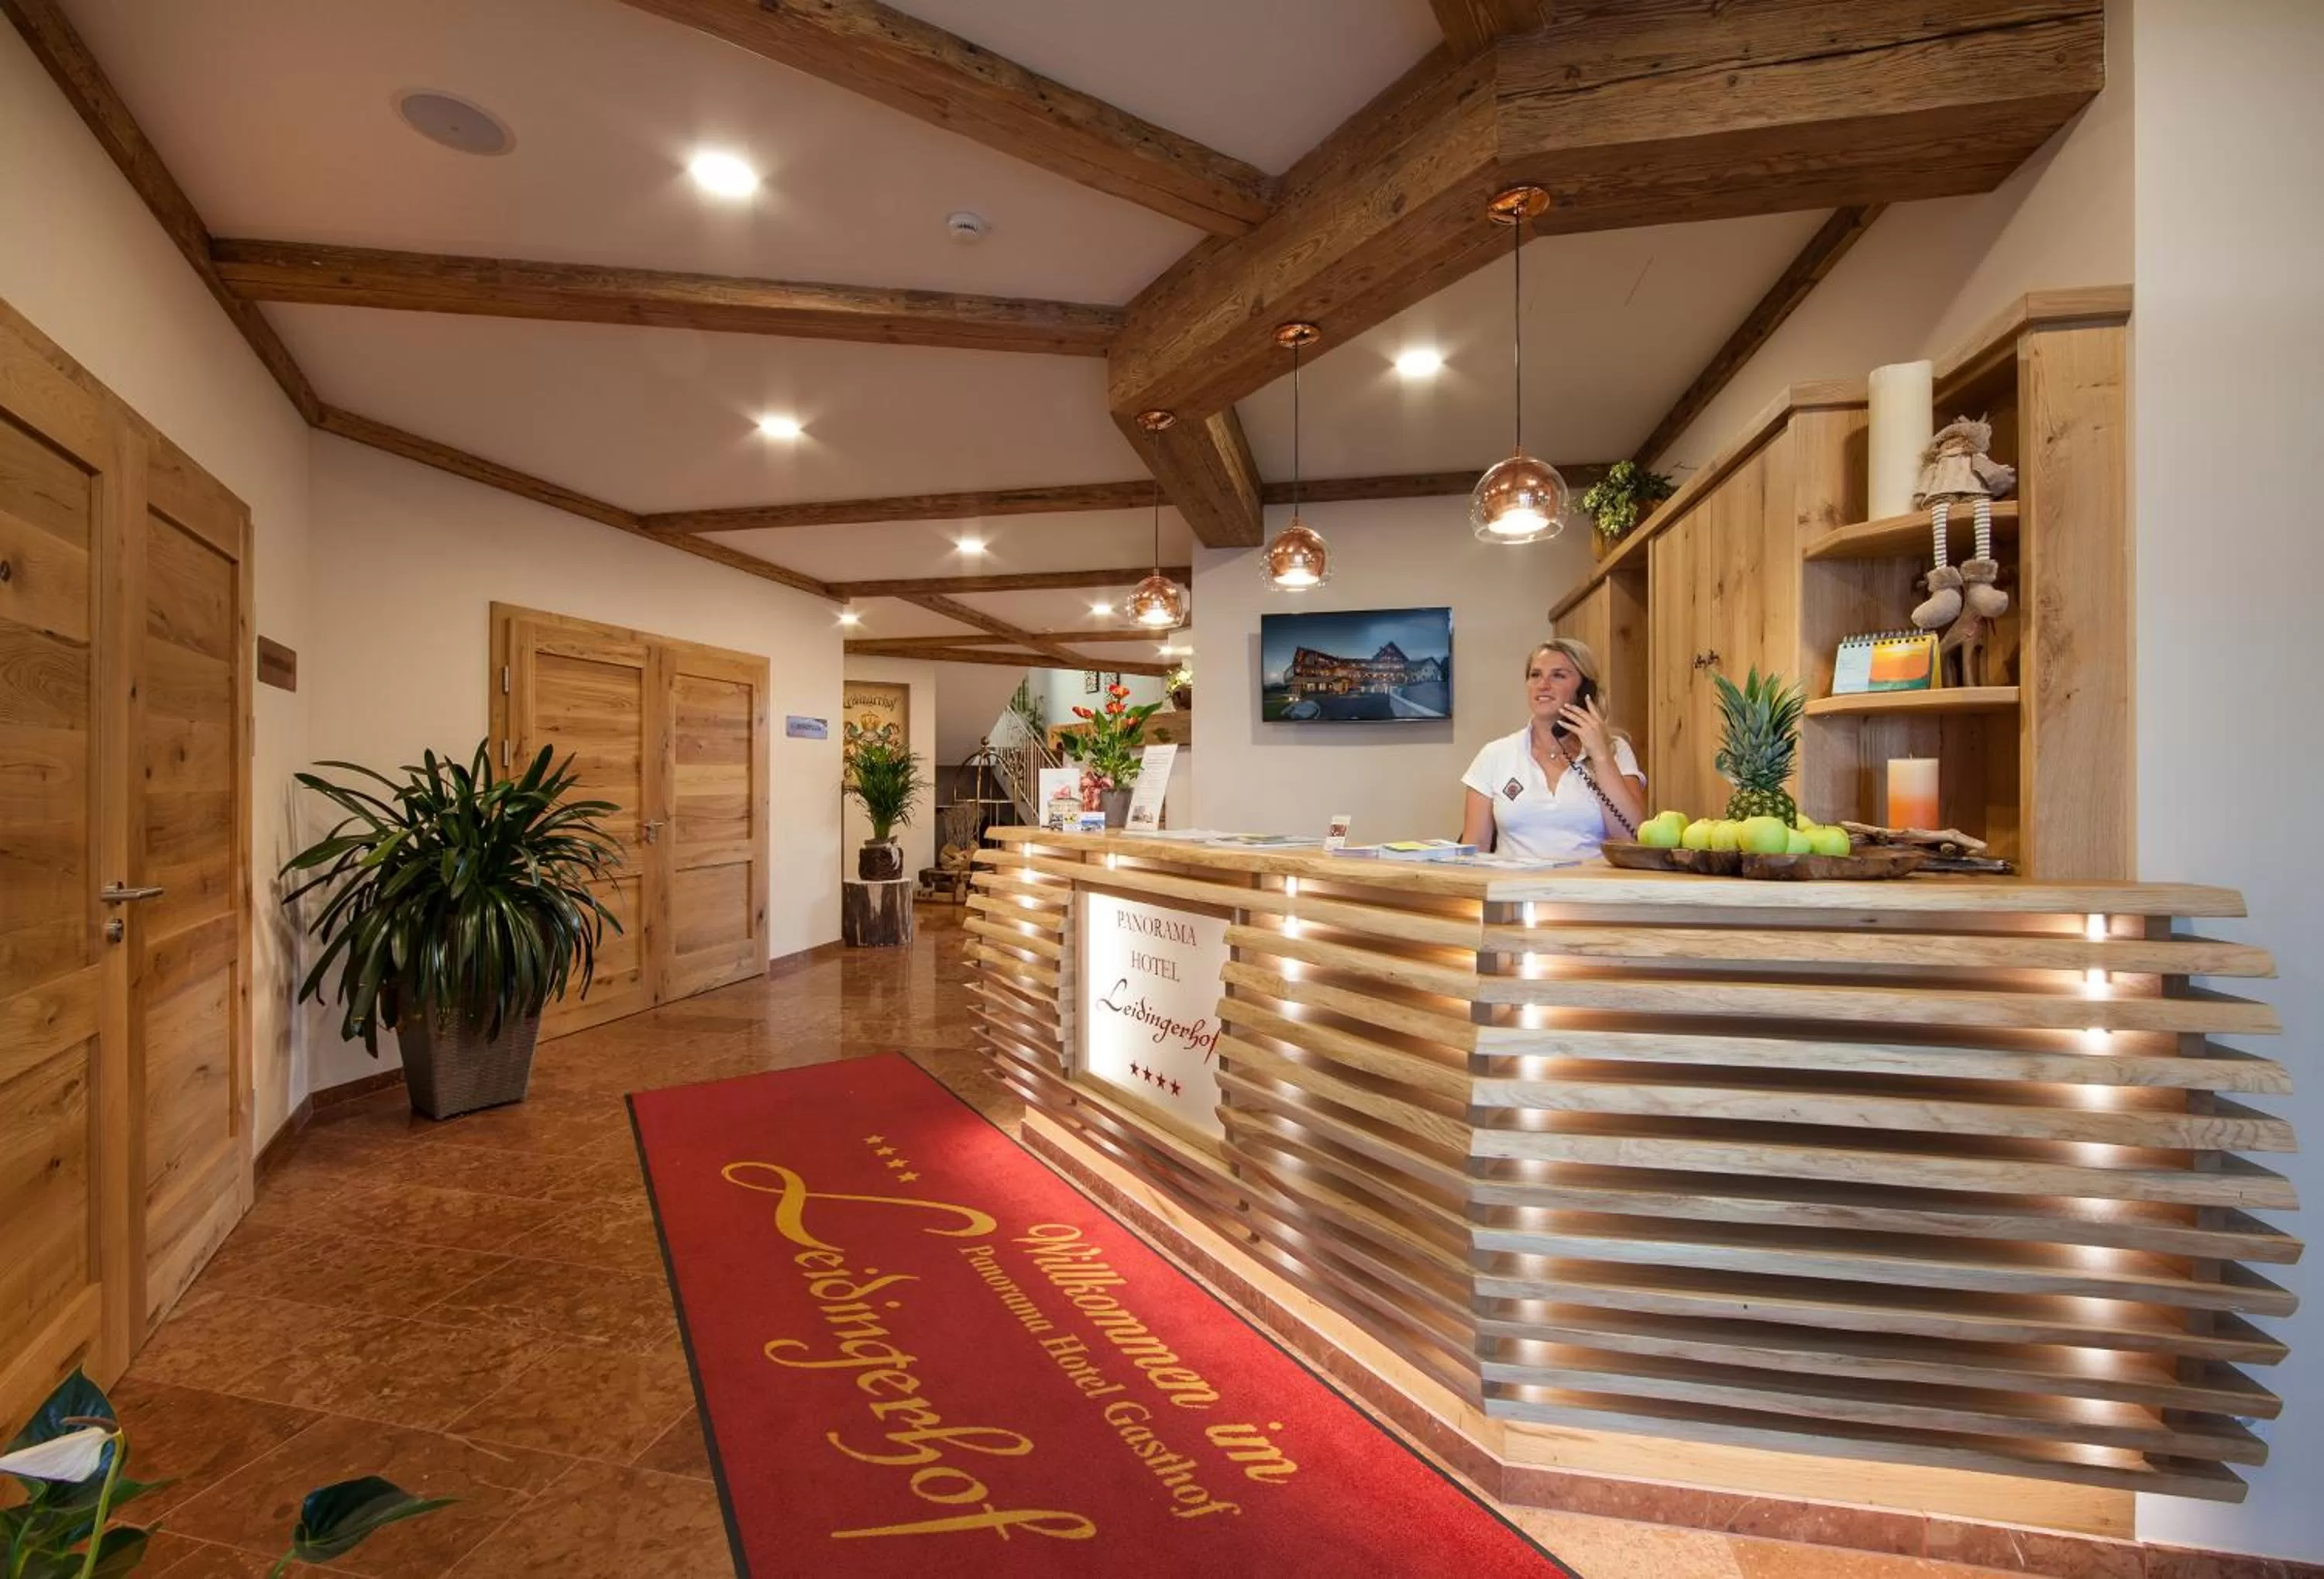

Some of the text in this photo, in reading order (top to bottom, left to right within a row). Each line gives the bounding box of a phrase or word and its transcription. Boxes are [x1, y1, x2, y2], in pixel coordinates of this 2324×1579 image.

[1117, 910, 1198, 946] PANORAMA
[1130, 949, 1181, 982] HOTEL
[1095, 978, 1222, 1065] Leidingerhof
[720, 1161, 1097, 1541] Leidingerhof
[957, 1244, 1241, 1519] Panorama Hotel Gasthof
[1011, 1223, 1298, 1484] Willkommen im
